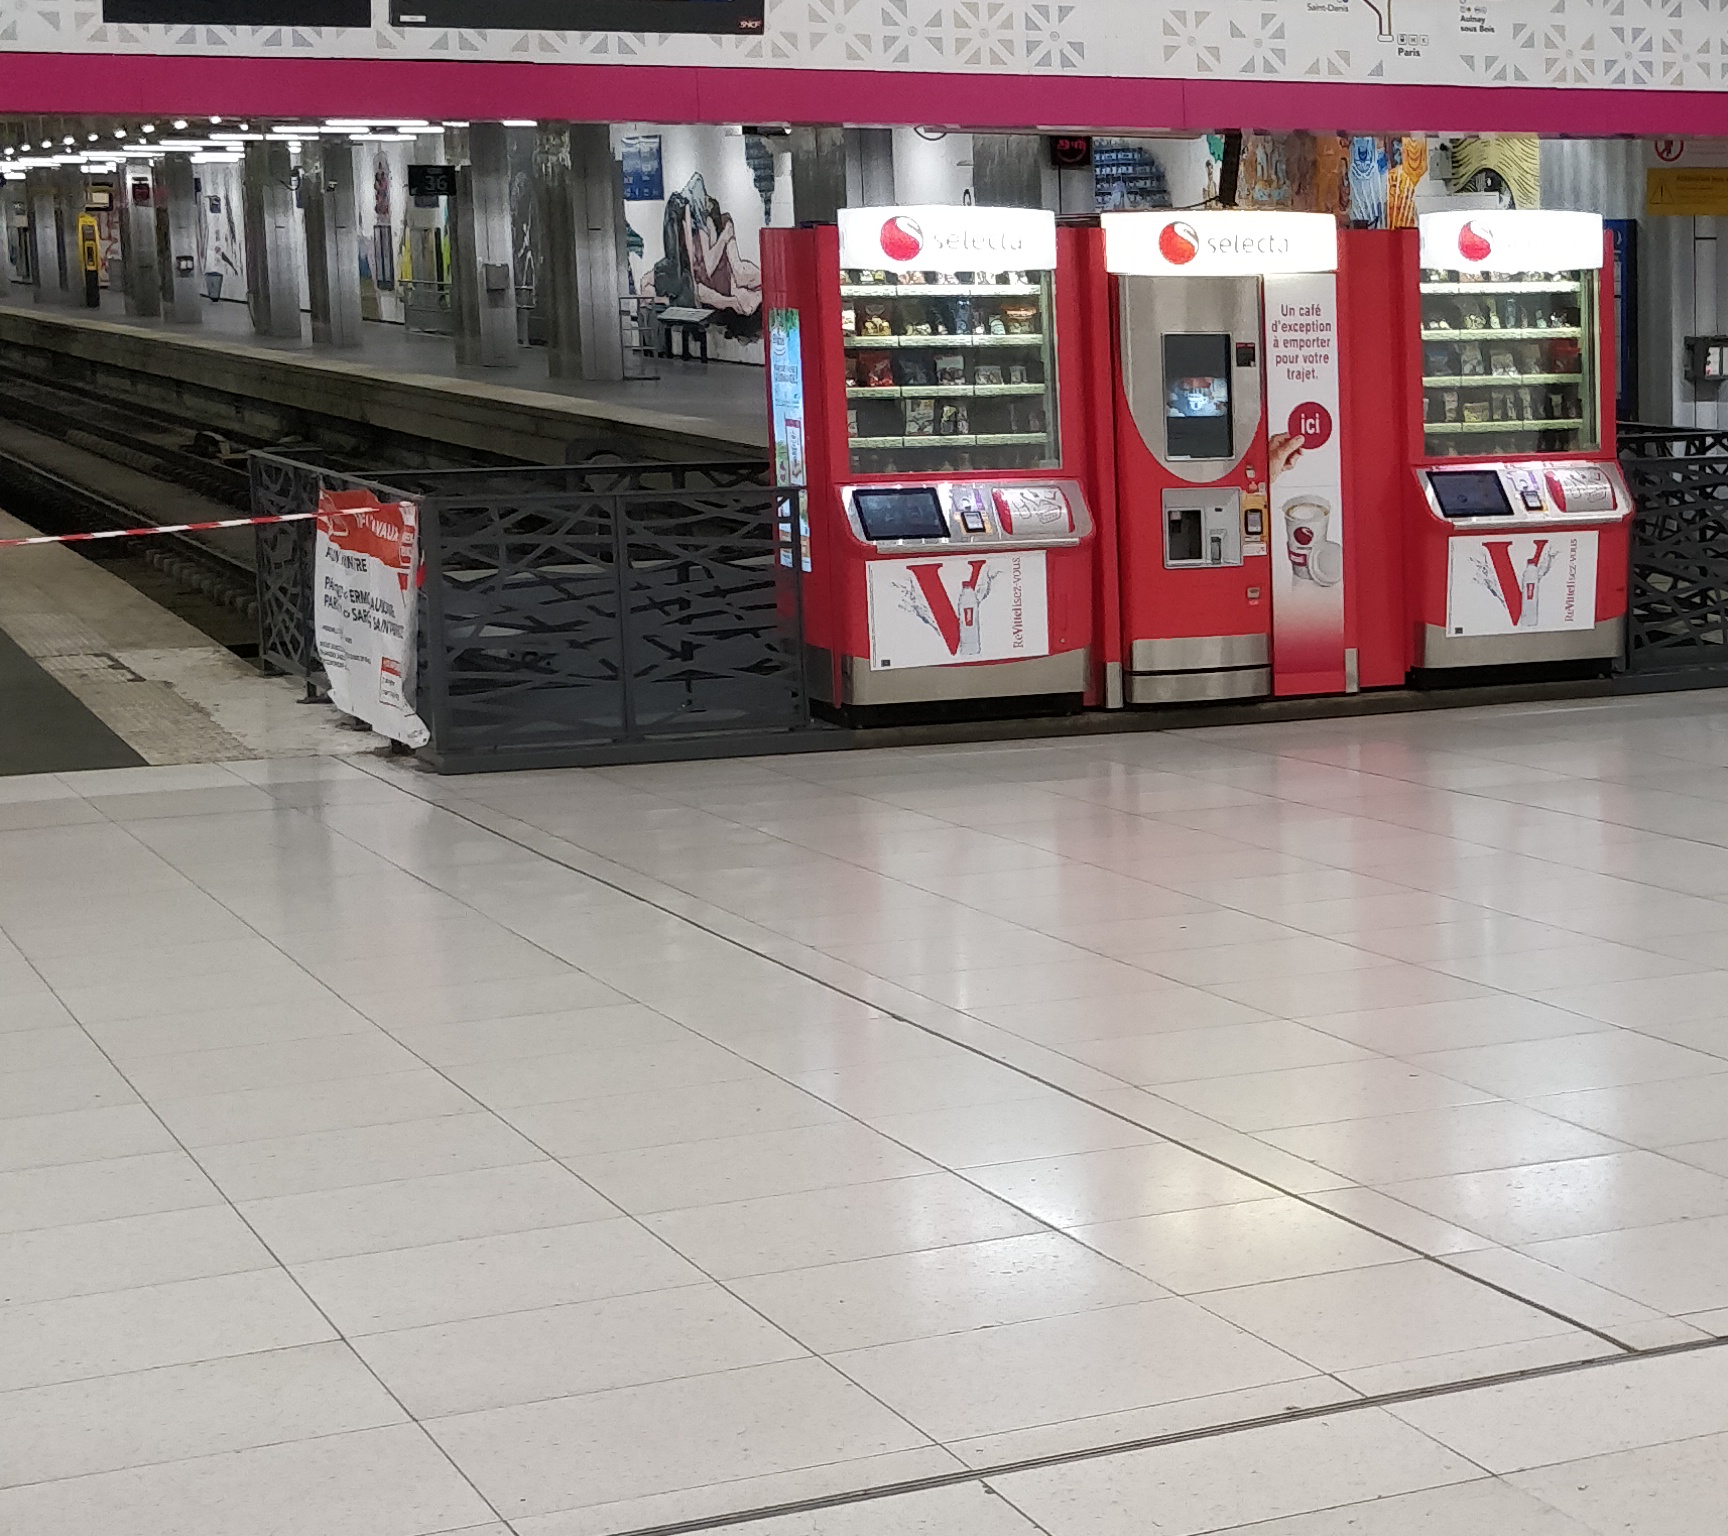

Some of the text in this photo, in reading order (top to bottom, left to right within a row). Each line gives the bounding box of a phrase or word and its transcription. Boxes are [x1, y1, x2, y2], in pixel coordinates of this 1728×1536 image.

[1281, 304, 1321, 316] Un café
[1272, 320, 1331, 334] d'exception
[1273, 336, 1330, 350] à emporter
[1276, 353, 1329, 366] pour votre
[1287, 368, 1318, 382] trajet.
[1301, 413, 1320, 434] ici
